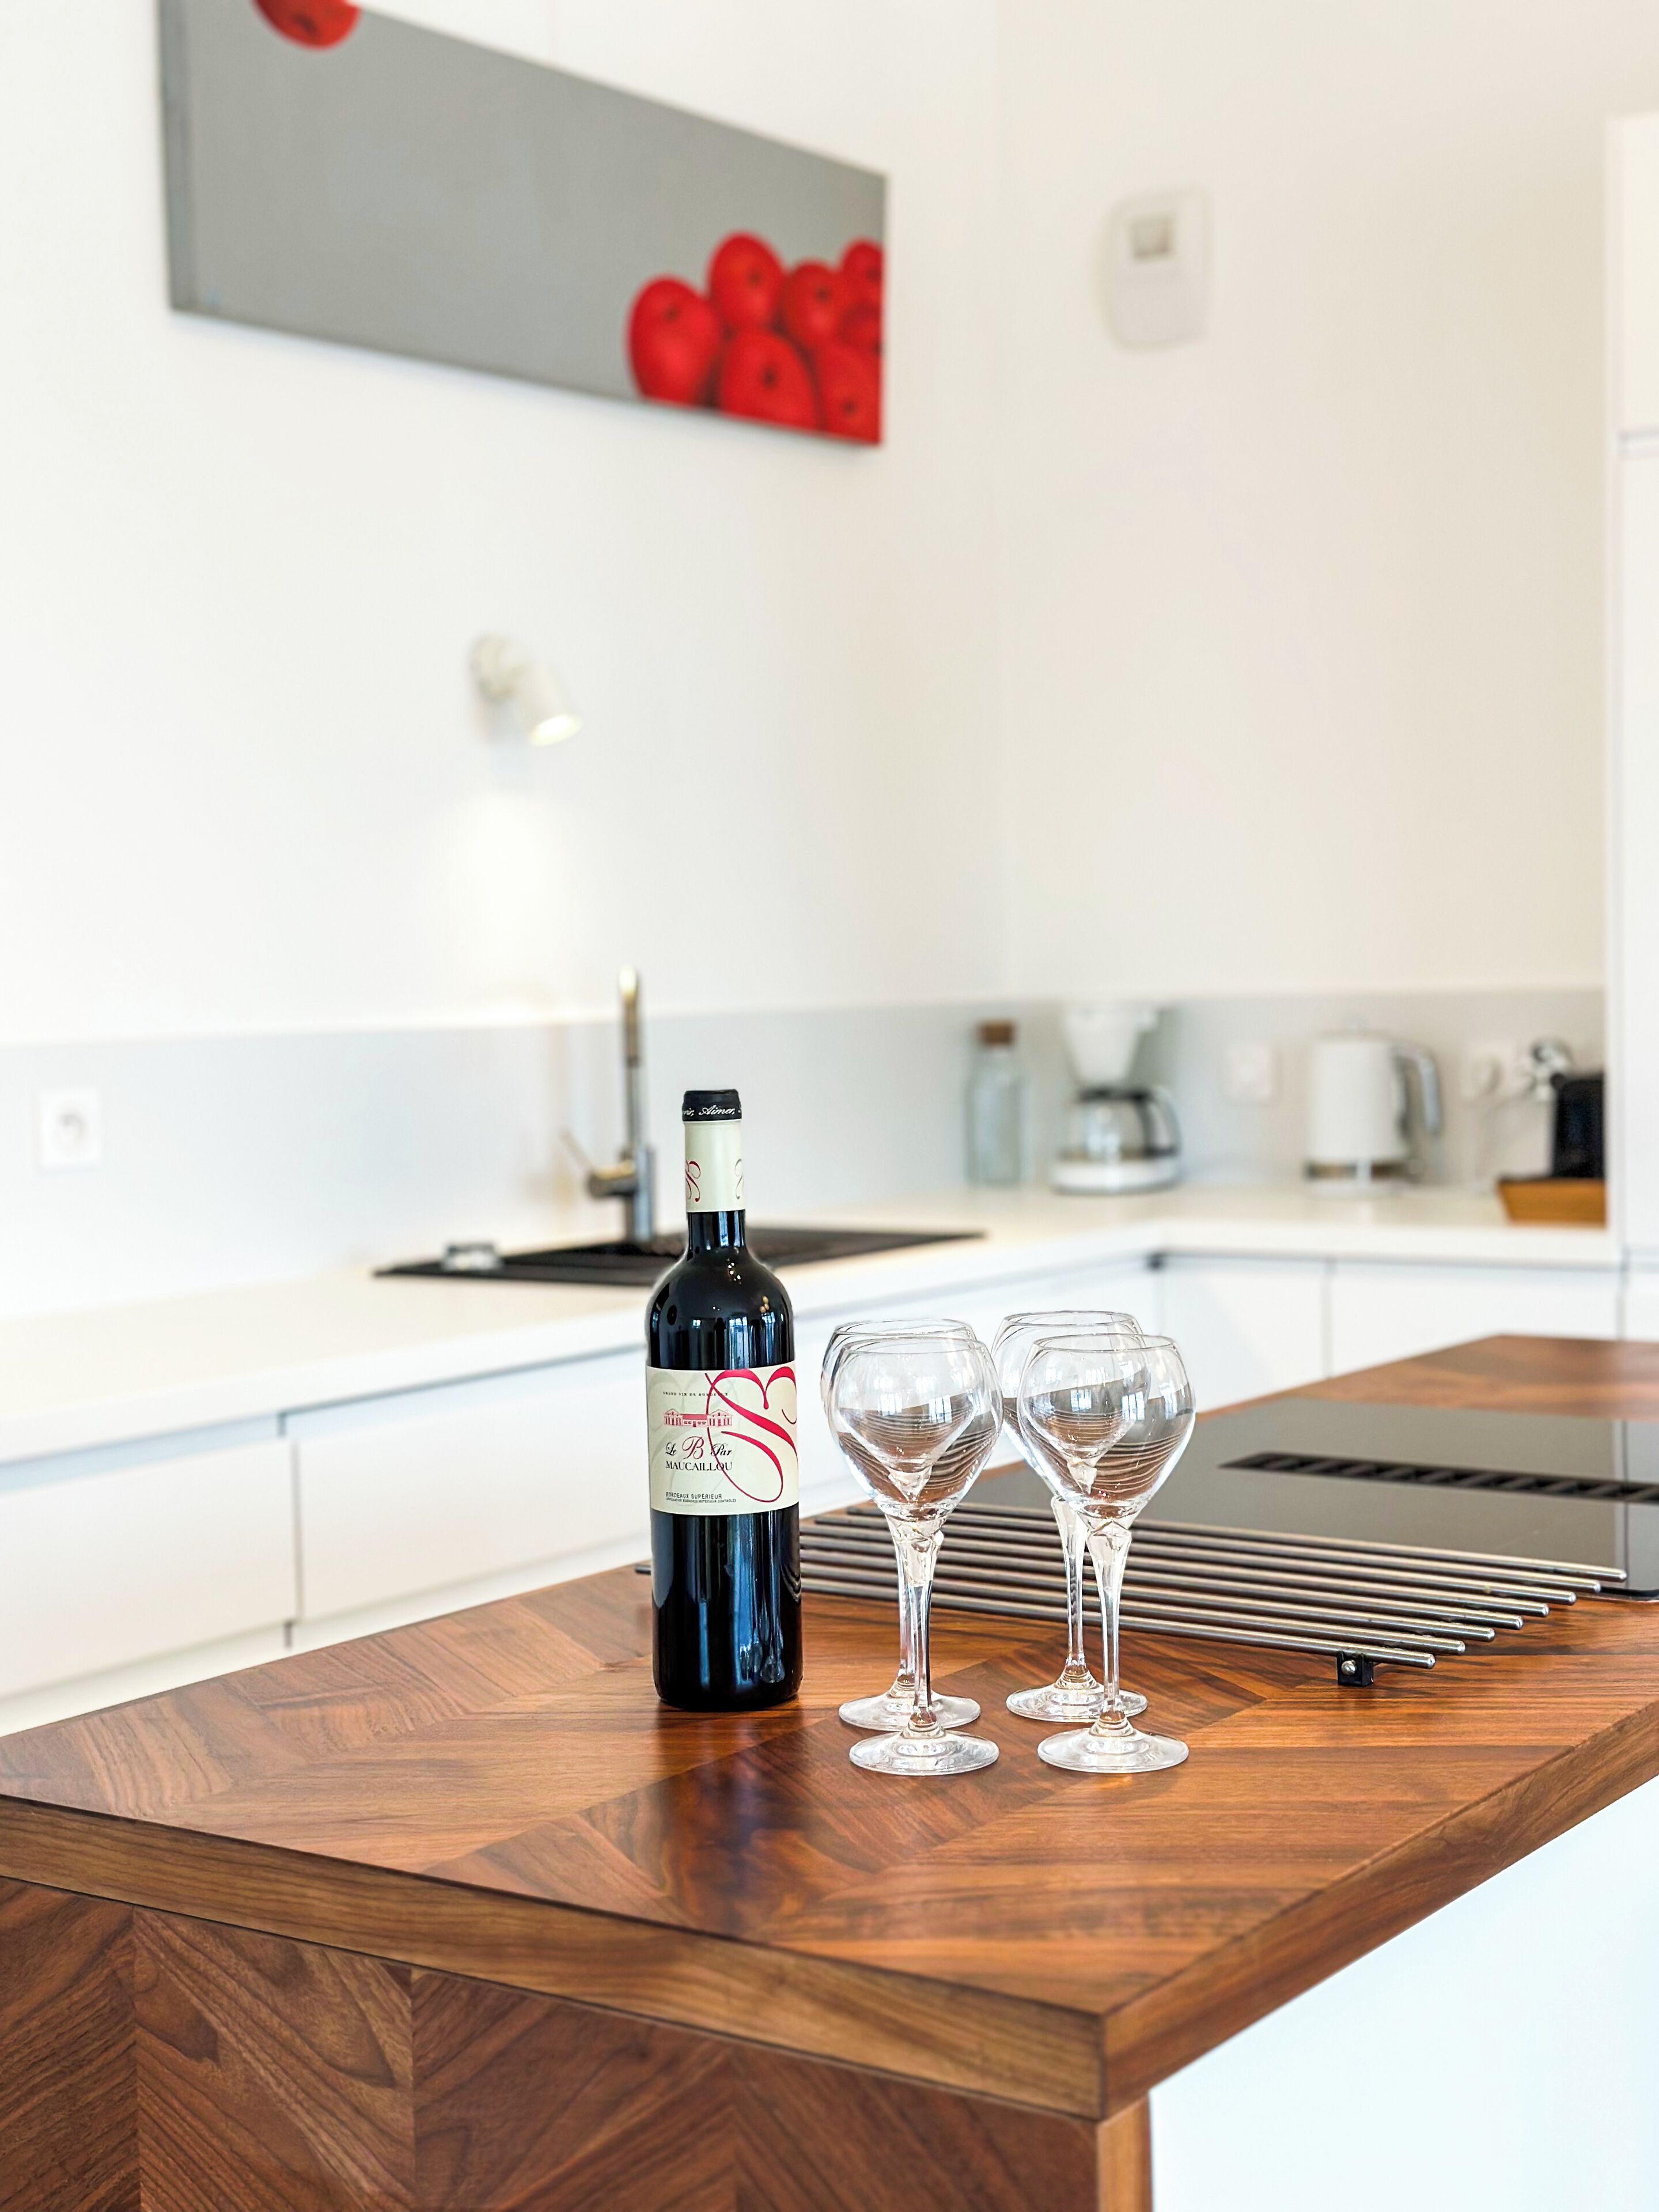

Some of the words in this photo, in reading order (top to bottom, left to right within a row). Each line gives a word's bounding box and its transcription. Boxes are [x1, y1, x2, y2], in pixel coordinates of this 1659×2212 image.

[698, 1104, 735, 1115] Aimer,
[665, 1442, 677, 1456] Le
[682, 1436, 704, 1459] B
[710, 1443, 732, 1456] Par
[666, 1460, 732, 1471] MAUCAILLOU
